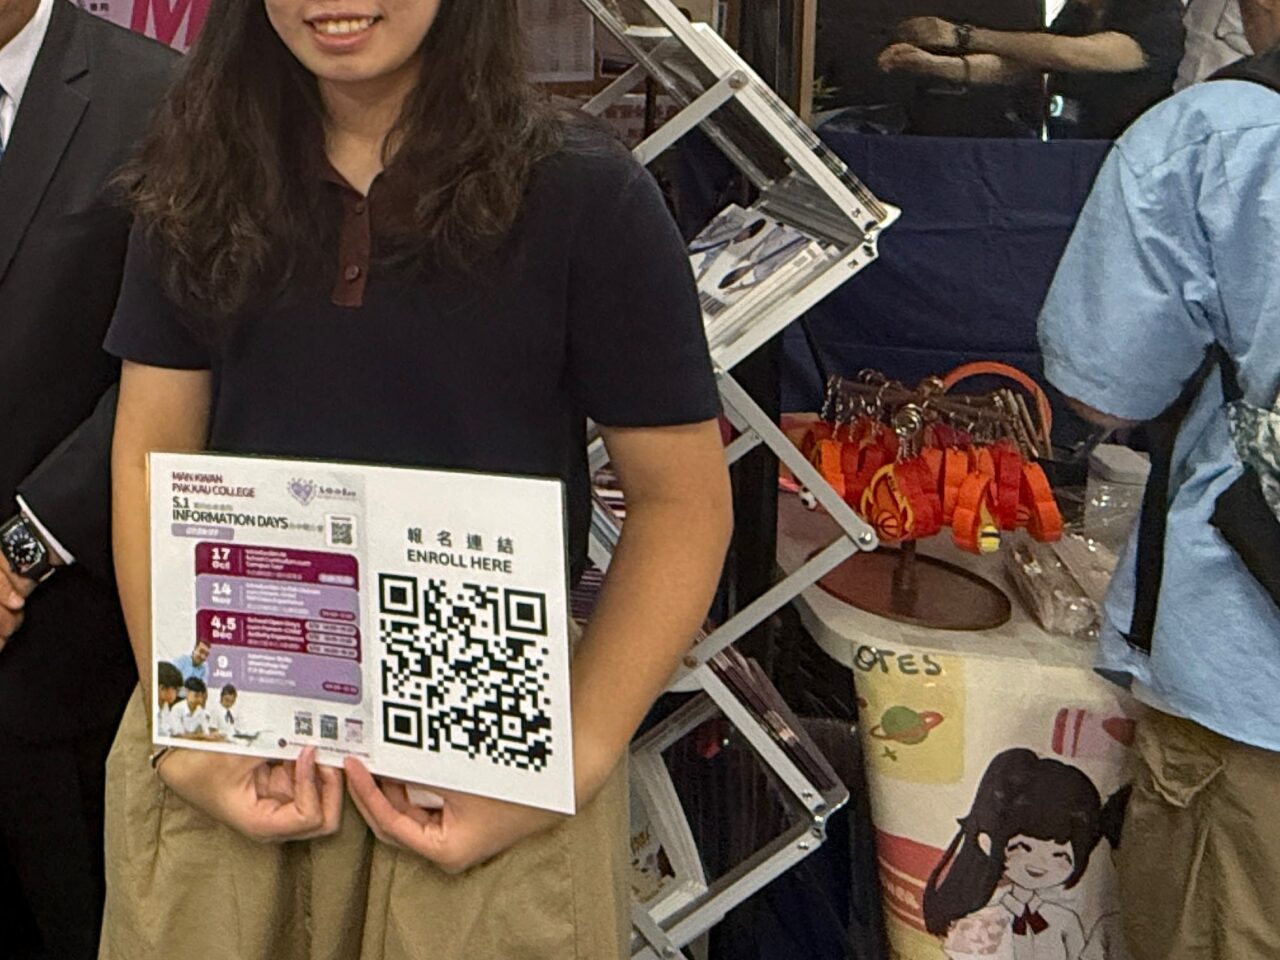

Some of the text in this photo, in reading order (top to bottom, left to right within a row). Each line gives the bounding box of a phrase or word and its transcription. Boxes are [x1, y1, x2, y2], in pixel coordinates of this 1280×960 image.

[212, 485, 256, 498] COLLEGE
[173, 509, 255, 527] INFORMATION
[257, 515, 289, 530] DAYS
[407, 527, 514, 555] 報名連結
[211, 547, 231, 560] 17
[407, 548, 513, 574] ENROLL HERE
[217, 655, 229, 669] 9
[213, 668, 233, 678] Jan
